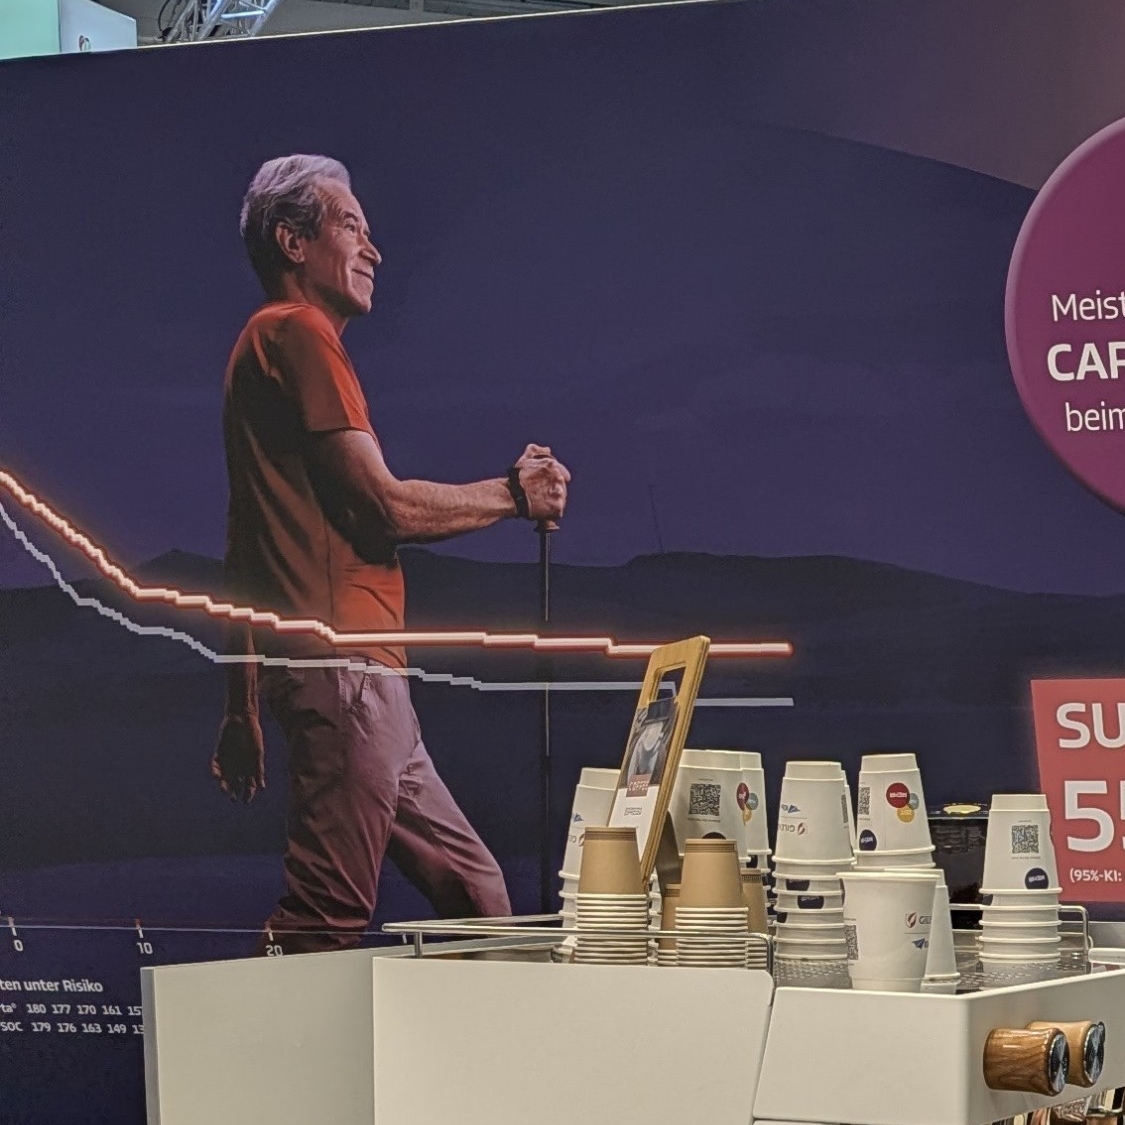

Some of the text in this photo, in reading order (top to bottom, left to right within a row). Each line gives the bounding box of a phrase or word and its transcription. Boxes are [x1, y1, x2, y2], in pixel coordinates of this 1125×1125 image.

[1069, 868, 1122, 884] (95%-KI:
[14, 939, 284, 957] 0 10 20
[23, 979, 60, 992] unter
[62, 979, 104, 992] Risiko
[26, 1003, 47, 1014] 180
[51, 1004, 71, 1014] 177
[76, 1005, 97, 1015] 170
[101, 1005, 123, 1015] 161
[127, 1006, 142, 1015] 15
[0, 1021, 23, 1031] SOC
[31, 1022, 52, 1032] 179
[57, 1022, 77, 1032] 176
[81, 1023, 102, 1033] 163
[106, 1023, 127, 1034] 149
